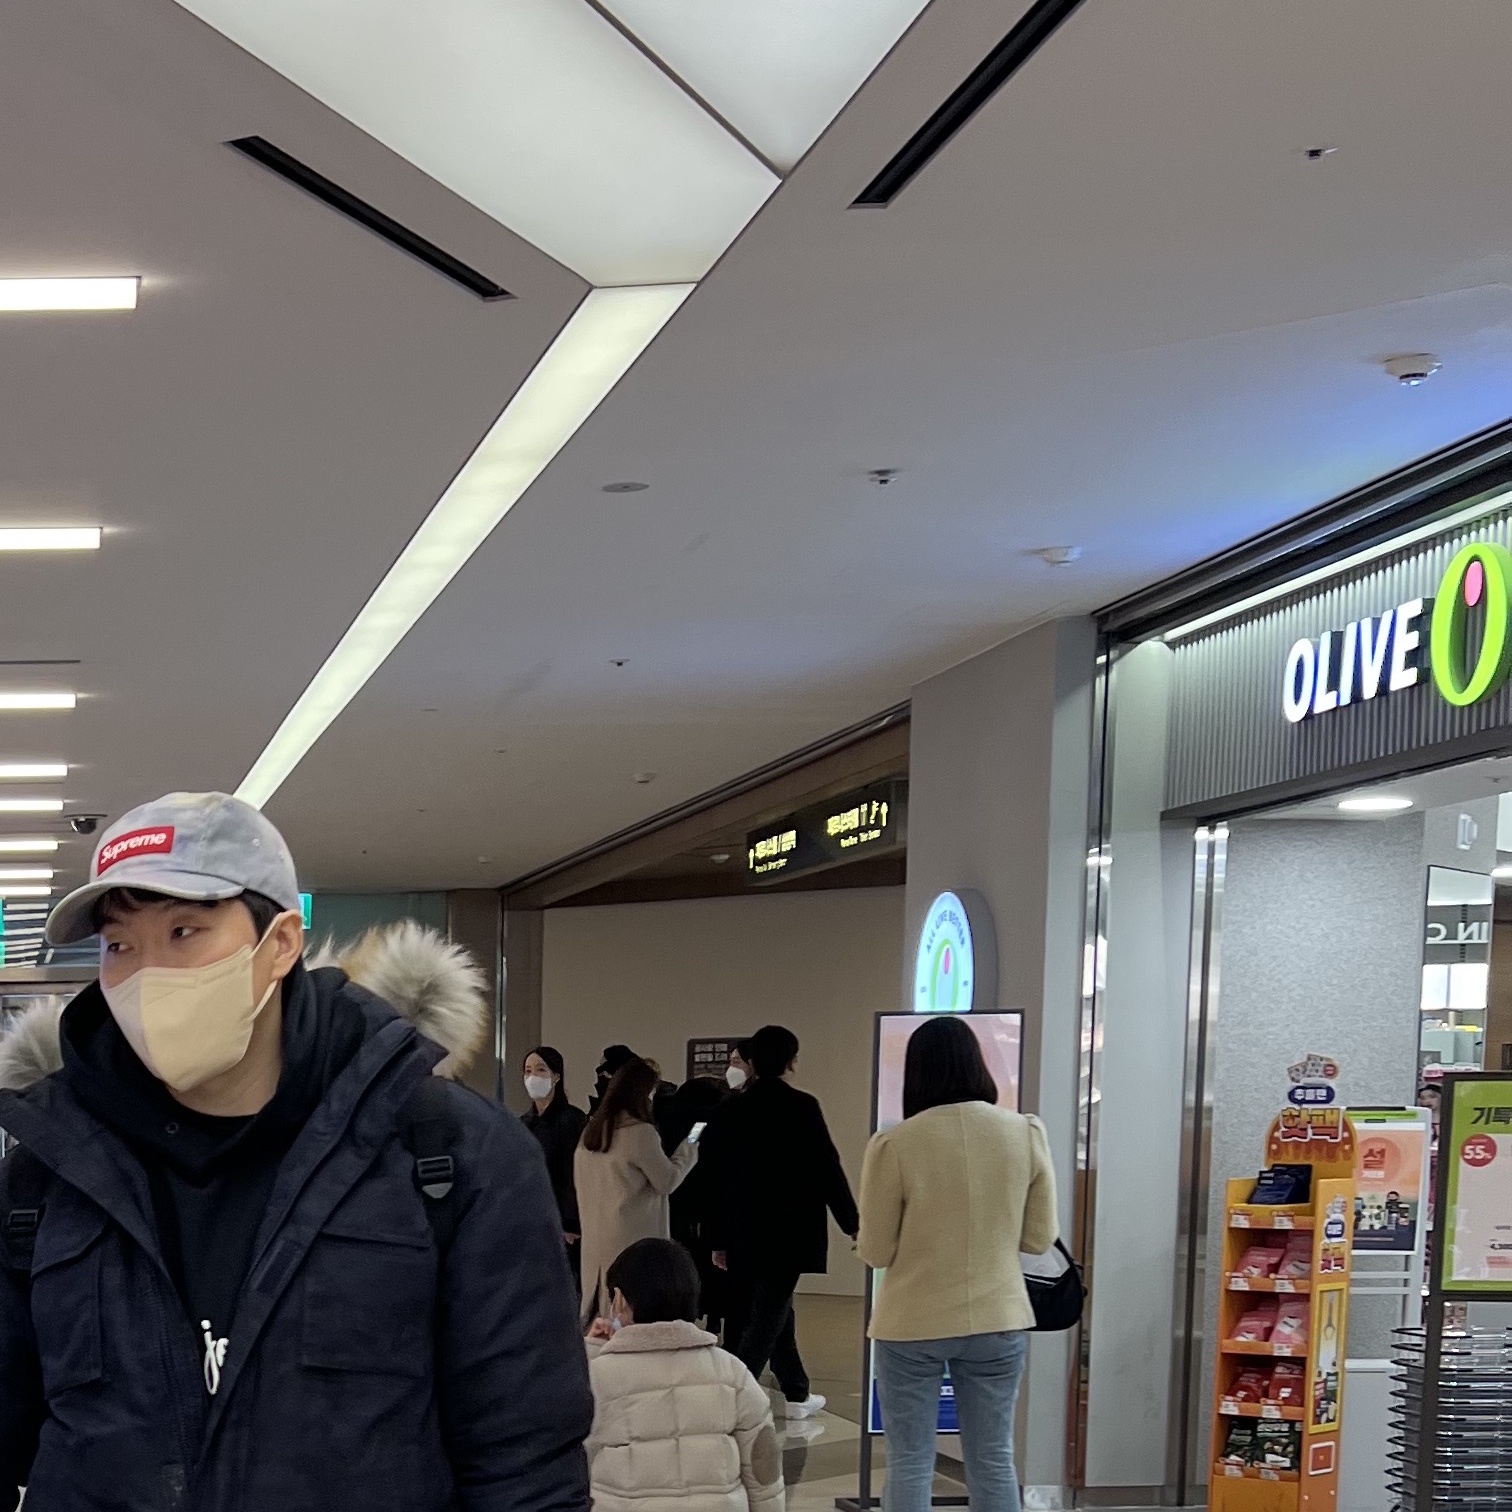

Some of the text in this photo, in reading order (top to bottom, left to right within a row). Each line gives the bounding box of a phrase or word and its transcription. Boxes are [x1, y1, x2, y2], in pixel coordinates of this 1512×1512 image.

[1282, 597, 1424, 724] OLIVE
[100, 832, 167, 864] Supreme
[1362, 1147, 1386, 1169] 설
